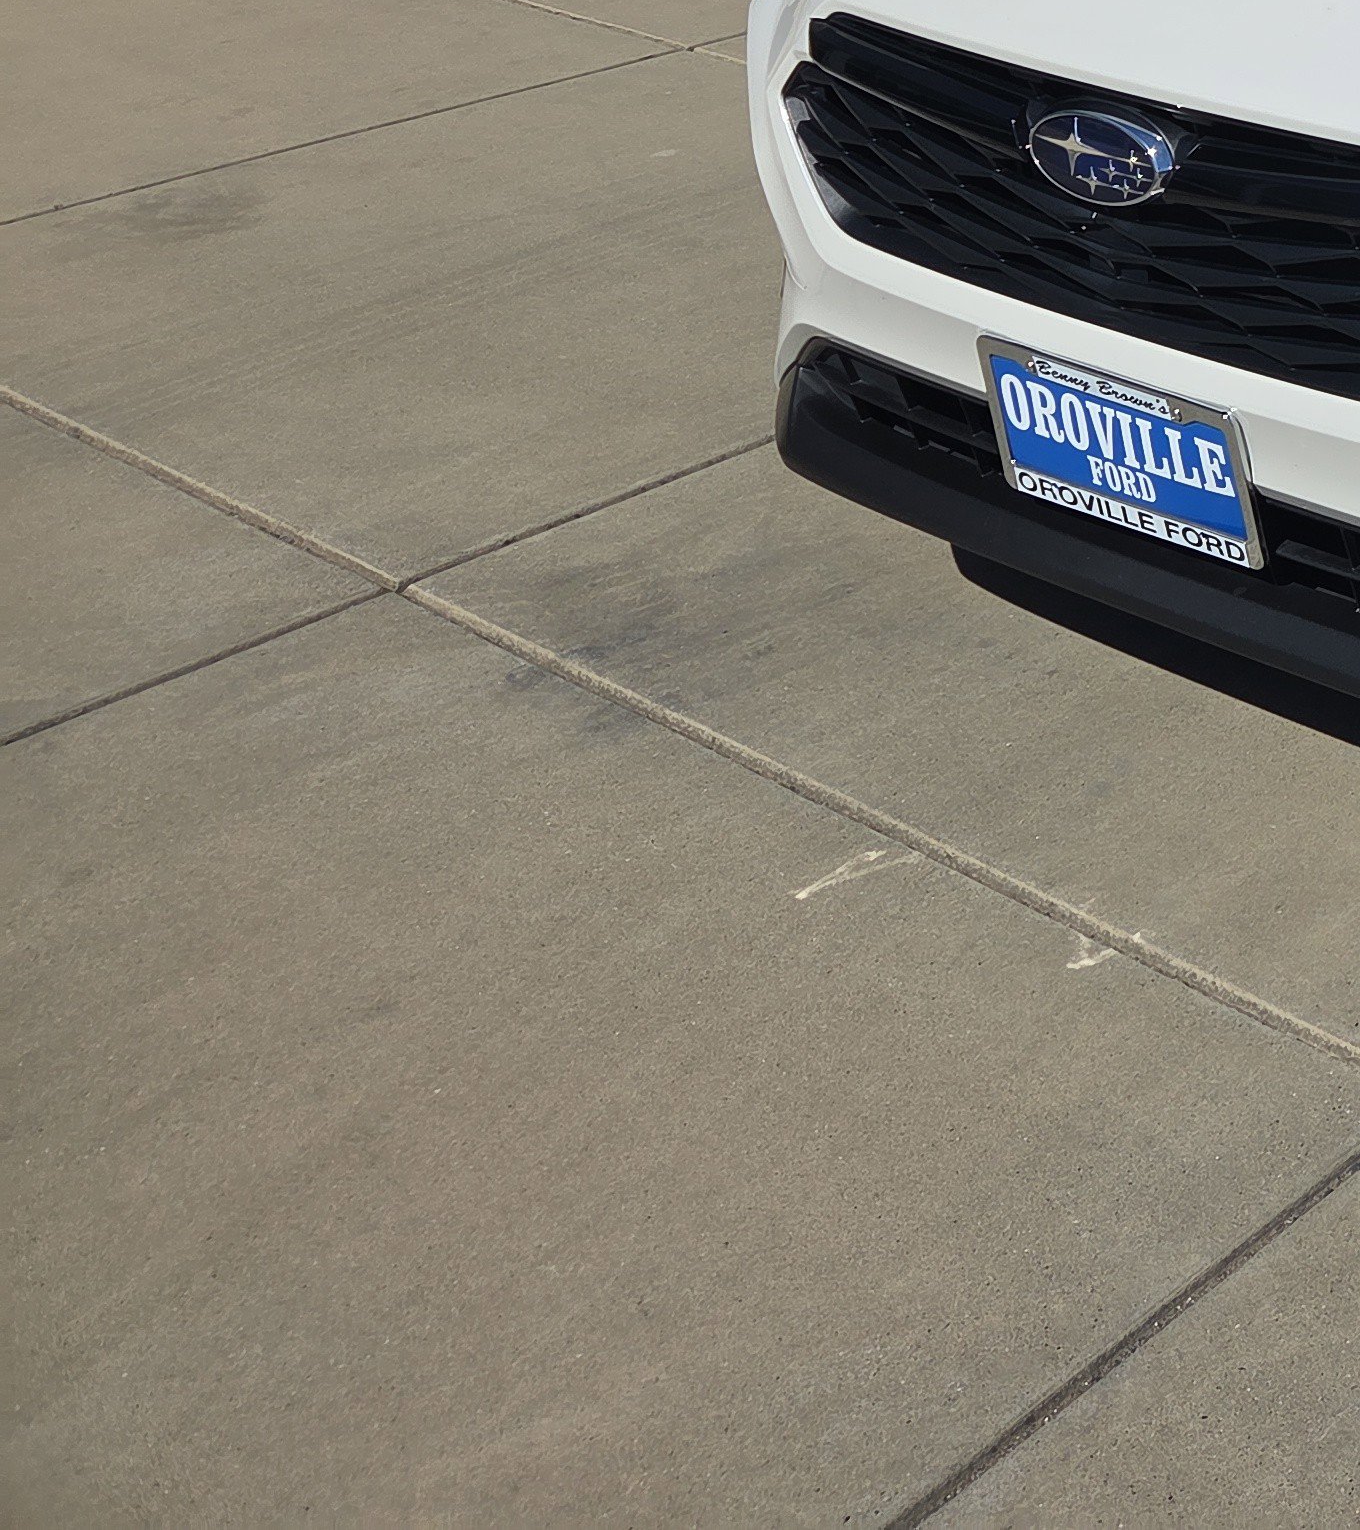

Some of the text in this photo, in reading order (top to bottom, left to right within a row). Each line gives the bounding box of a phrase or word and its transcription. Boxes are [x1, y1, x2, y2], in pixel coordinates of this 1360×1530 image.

[1035, 358, 1170, 415] Benny Brown's
[1000, 372, 1237, 498] OROVILLE
[1086, 454, 1157, 503] FORD
[1017, 471, 1246, 564] OROVILLE FORD
